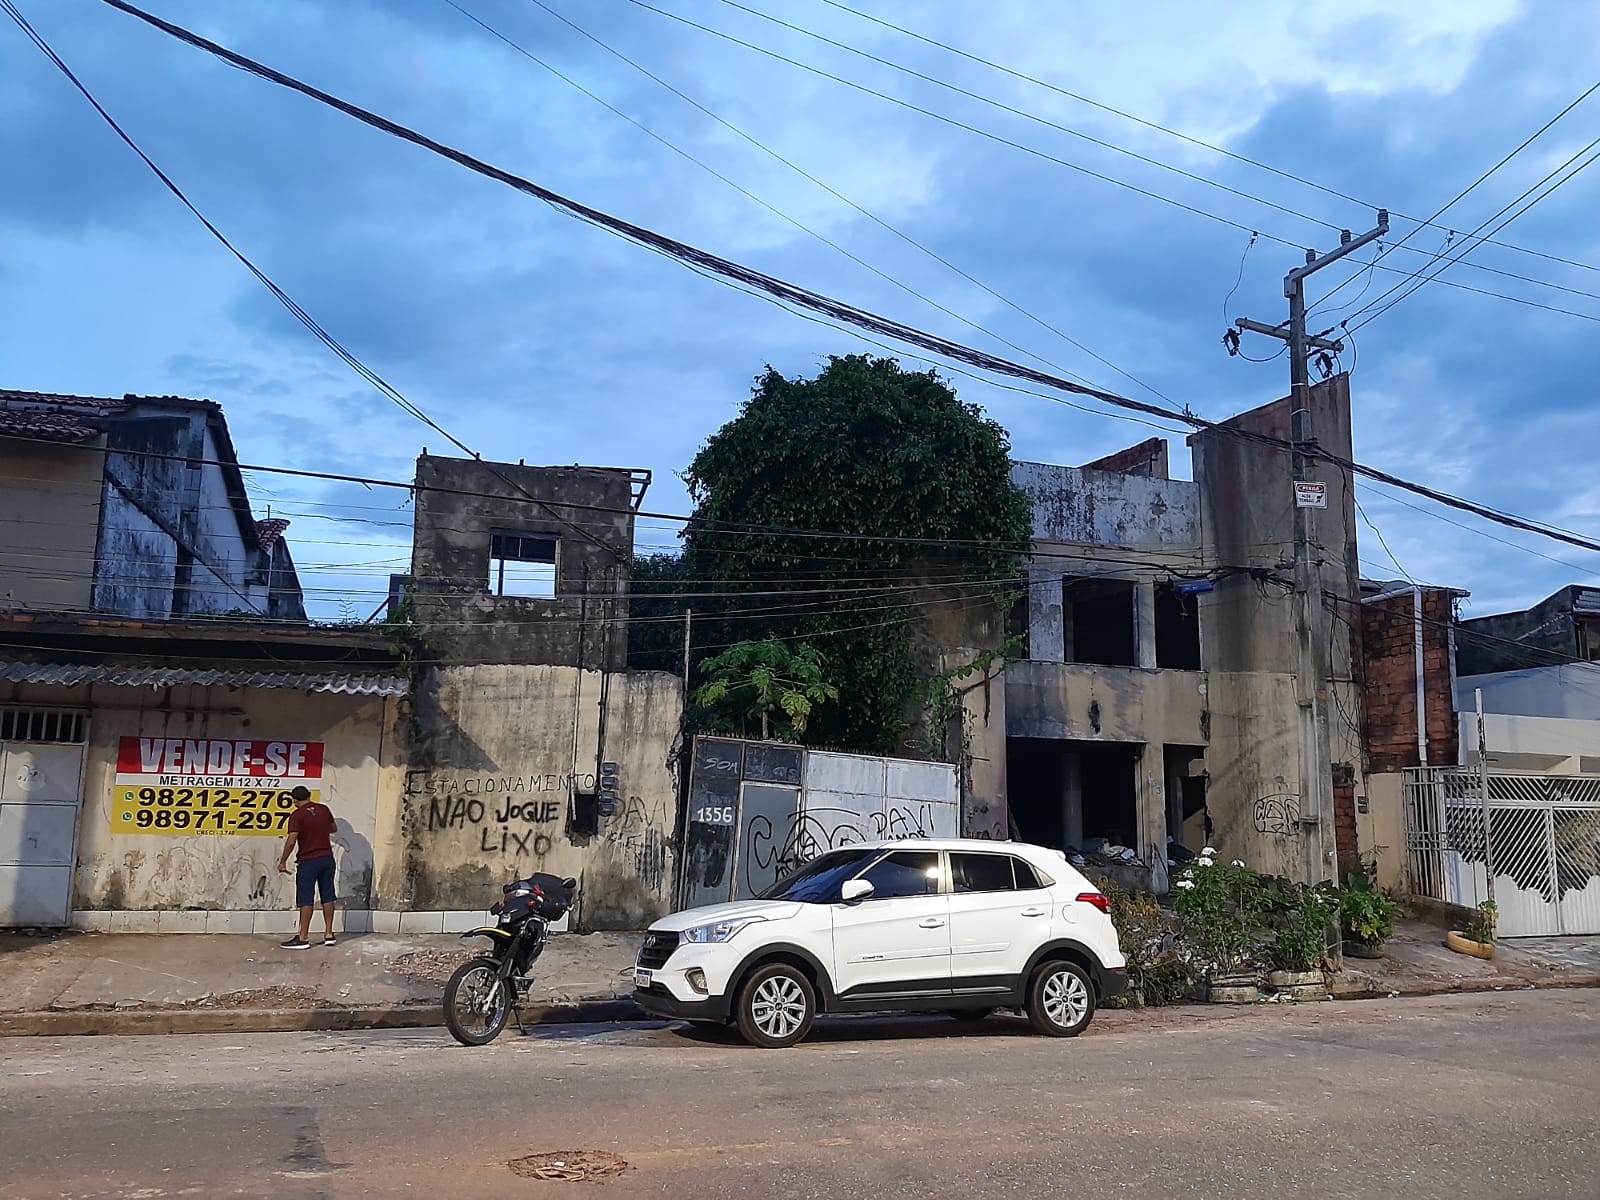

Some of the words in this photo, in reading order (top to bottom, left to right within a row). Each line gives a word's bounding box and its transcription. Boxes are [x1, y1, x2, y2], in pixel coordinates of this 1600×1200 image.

[140, 737, 307, 777] VENDE-SE
[159, 776, 234, 788] METRAGEM
[237, 778, 251, 788] 12
[254, 779, 264, 788] X
[266, 779, 281, 788] 72
[138, 787, 294, 809] 98212-276
[136, 809, 291, 830] 98971-297
[697, 806, 733, 823] 1356
[869, 803, 935, 834] DAVI
